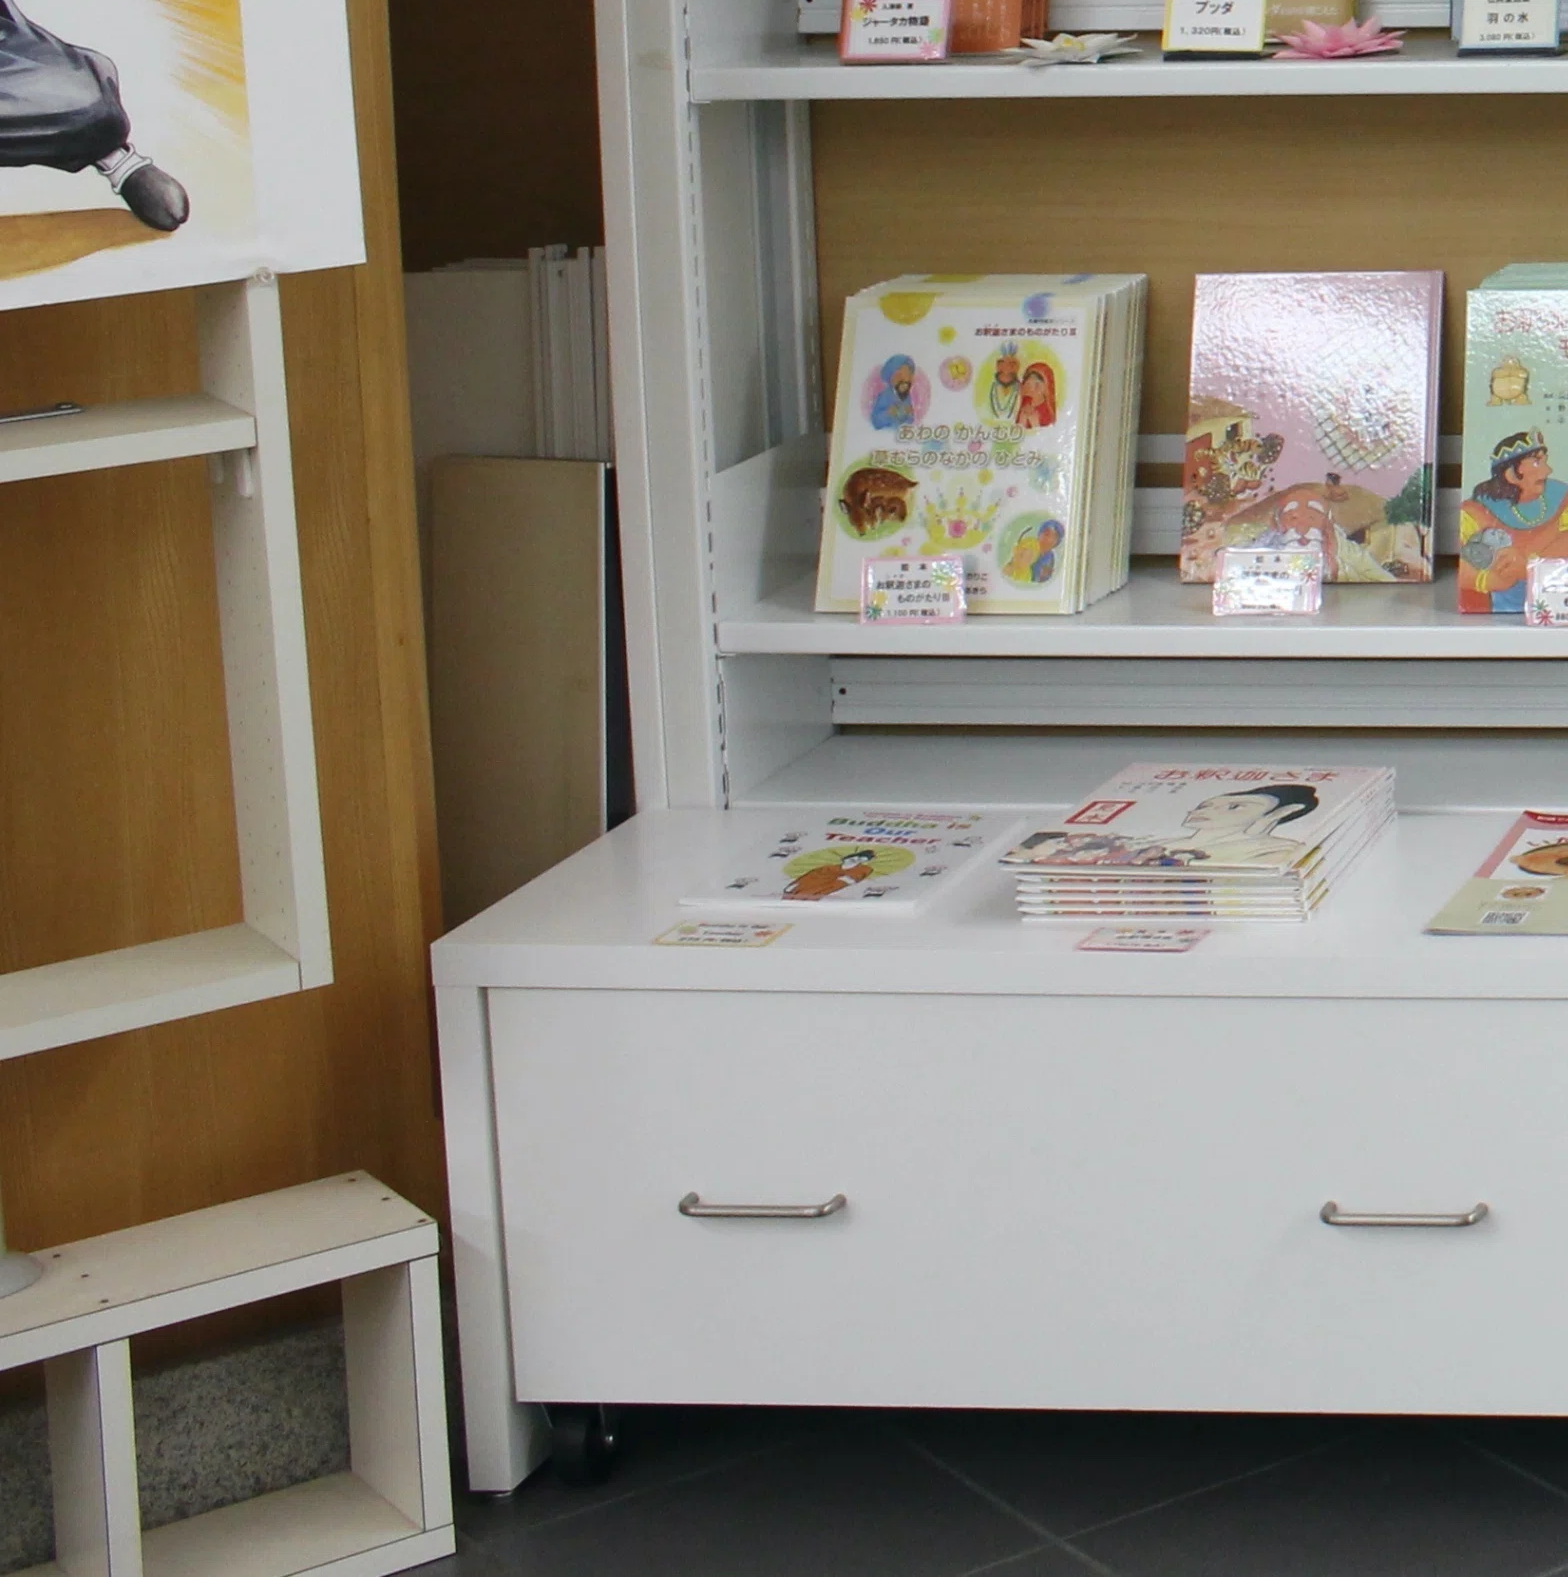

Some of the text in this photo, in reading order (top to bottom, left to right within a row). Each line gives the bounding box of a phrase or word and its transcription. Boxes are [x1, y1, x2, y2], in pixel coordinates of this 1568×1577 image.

[1195, 0, 1234, 14] ブッダ
[1486, 12, 1529, 24] 羽の水
[870, 450, 1045, 468] 草むらのなかの ひとみ
[1153, 768, 1340, 783] お釈迦さま
